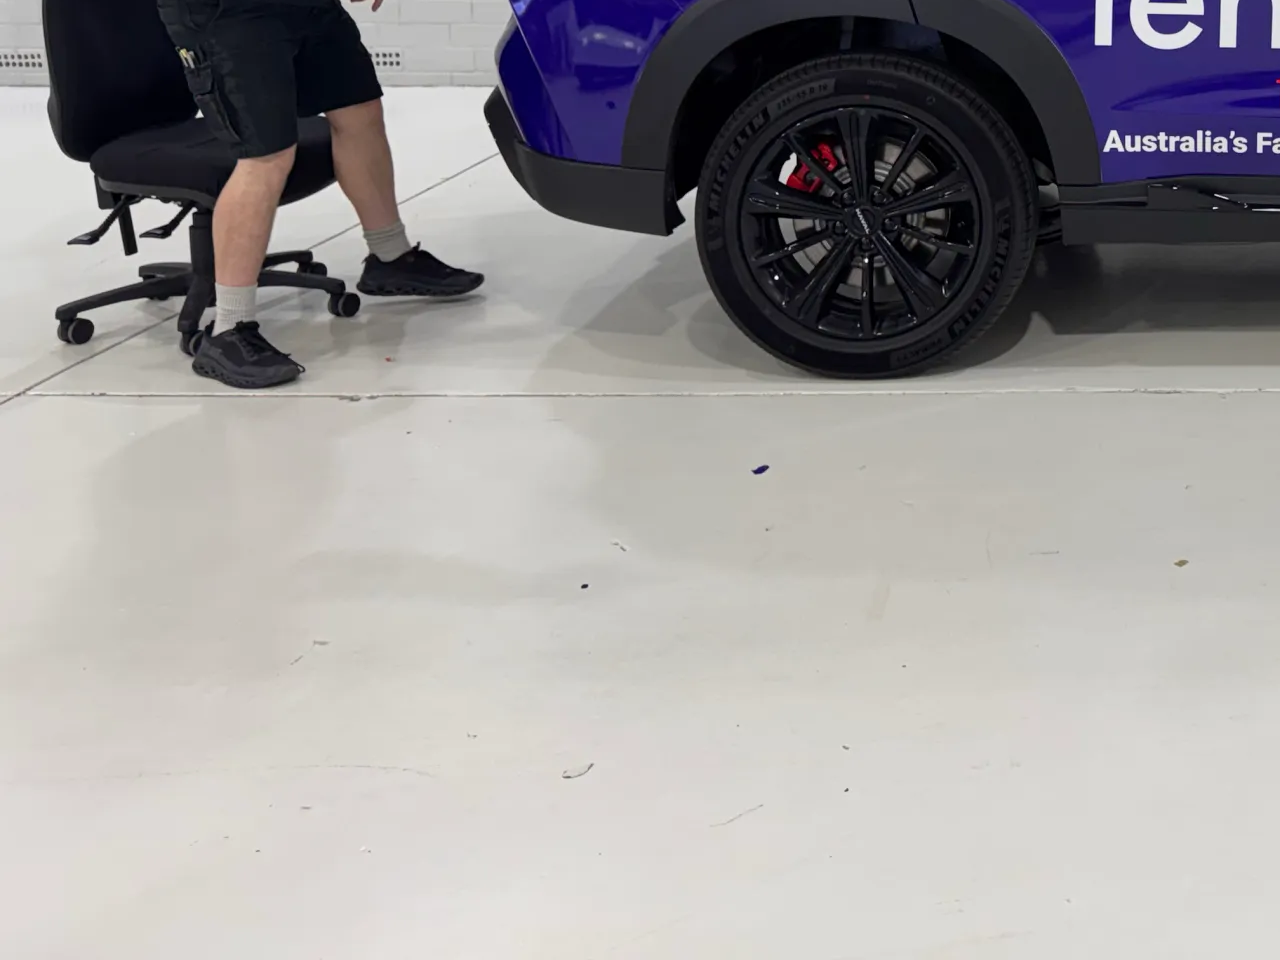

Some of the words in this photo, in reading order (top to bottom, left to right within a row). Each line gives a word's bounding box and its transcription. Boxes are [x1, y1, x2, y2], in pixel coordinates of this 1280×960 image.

[709, 107, 770, 216] MICHELIN
[1102, 129, 1248, 154] Australia's
[949, 233, 1012, 338] MICHELIN
